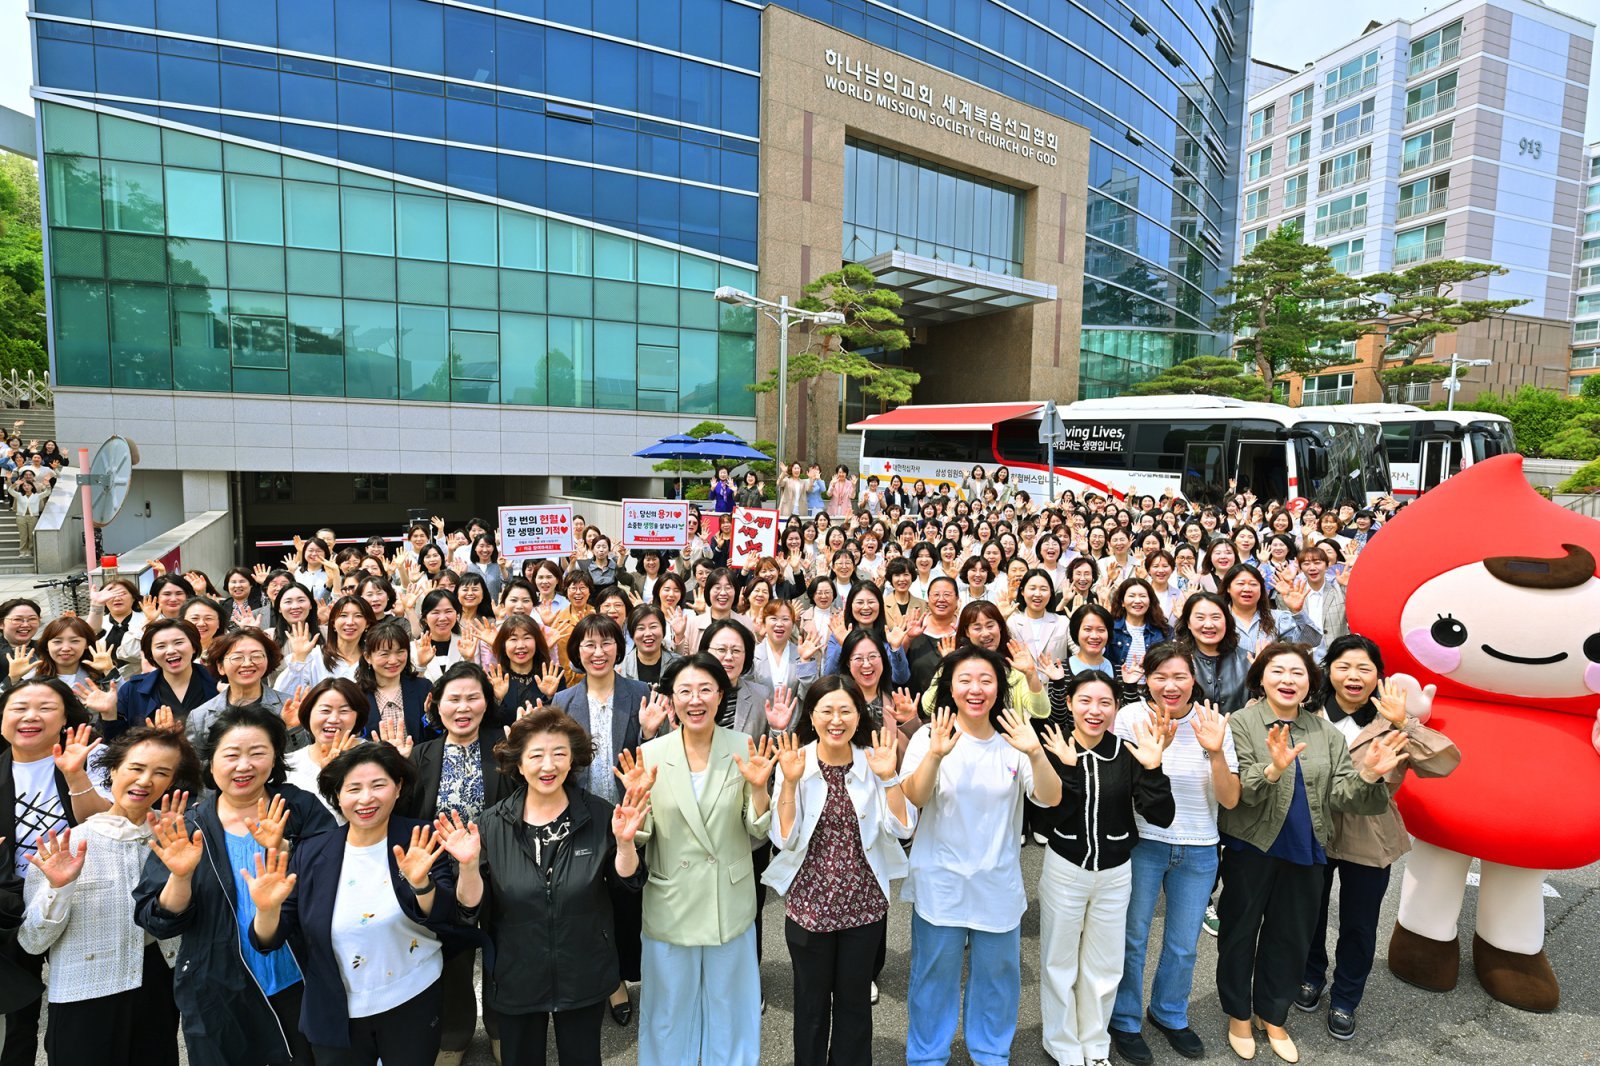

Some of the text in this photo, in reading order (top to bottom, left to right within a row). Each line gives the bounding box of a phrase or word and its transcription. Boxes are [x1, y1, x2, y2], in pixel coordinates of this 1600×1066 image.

[825, 74, 1057, 166] WORLD MISSION SOCIETY CHURCH OF GOD
[942, 94, 1058, 152] 세계복음선교협회
[1519, 137, 1543, 159] 913
[1065, 425, 1126, 440] ving Lives,
[1082, 441, 1123, 452] 생명입니다.
[1391, 472, 1410, 481] 자사
[508, 514, 558, 526] 한 번의 헌혈
[640, 510, 657, 519] 당신의
[658, 509, 673, 519] 용기
[507, 525, 560, 537] 한 생명의 기적
[627, 521, 642, 530] 소중한
